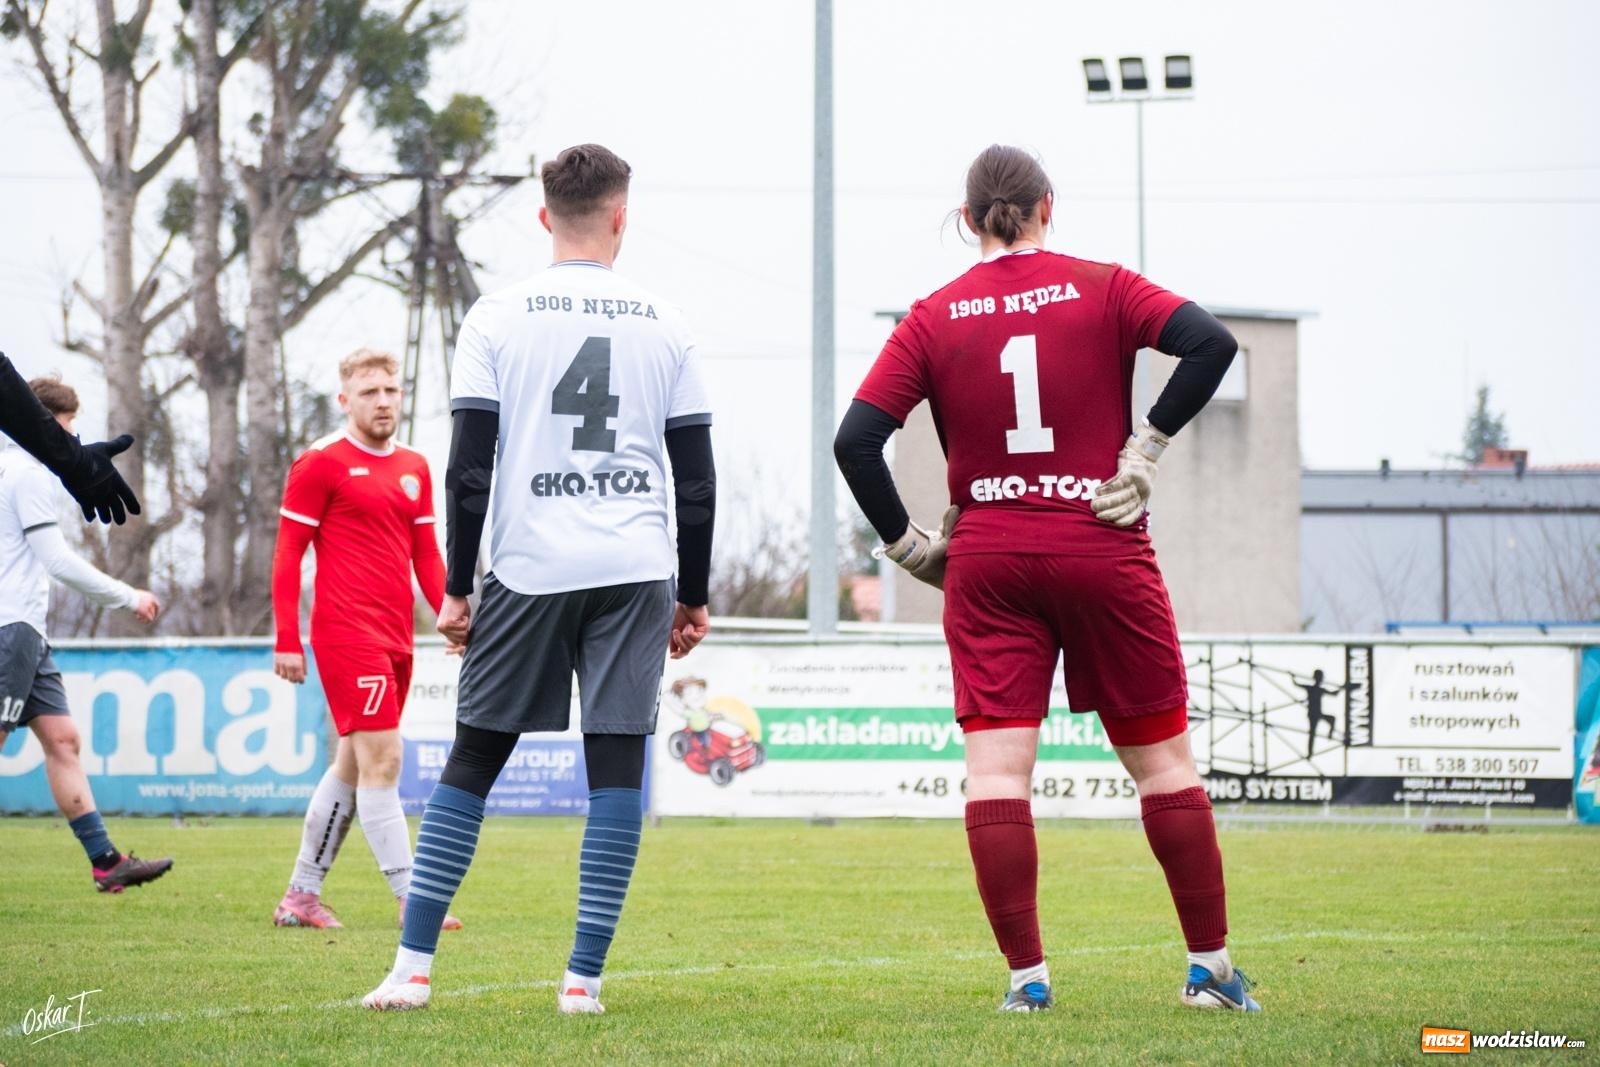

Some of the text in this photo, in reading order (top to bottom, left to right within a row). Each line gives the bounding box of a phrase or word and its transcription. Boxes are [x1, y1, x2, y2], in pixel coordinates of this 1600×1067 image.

[526, 295, 659, 320] 1908 NĘDZA
[949, 283, 1081, 319] 1908 NĘDZA
[552, 336, 620, 453] 4
[1000, 334, 1055, 455] 1
[530, 470, 652, 497] EKO-TOX
[970, 475, 1102, 502] EKO-TOX
[1414, 661, 1515, 677] rusztowań
[357, 674, 388, 716] 7
[1349, 647, 1370, 745] WYNAJEM
[1410, 686, 1520, 703] i szalunków
[1, 696, 25, 723] 10
[1409, 713, 1520, 732] stropowych
[1435, 757, 1466, 773] 538
[1472, 758, 1503, 773] 300
[1508, 758, 1540, 774] 507
[898, 778, 949, 798] +48
[1086, 778, 1137, 798] 735
[1245, 777, 1333, 801] SYSTEM
